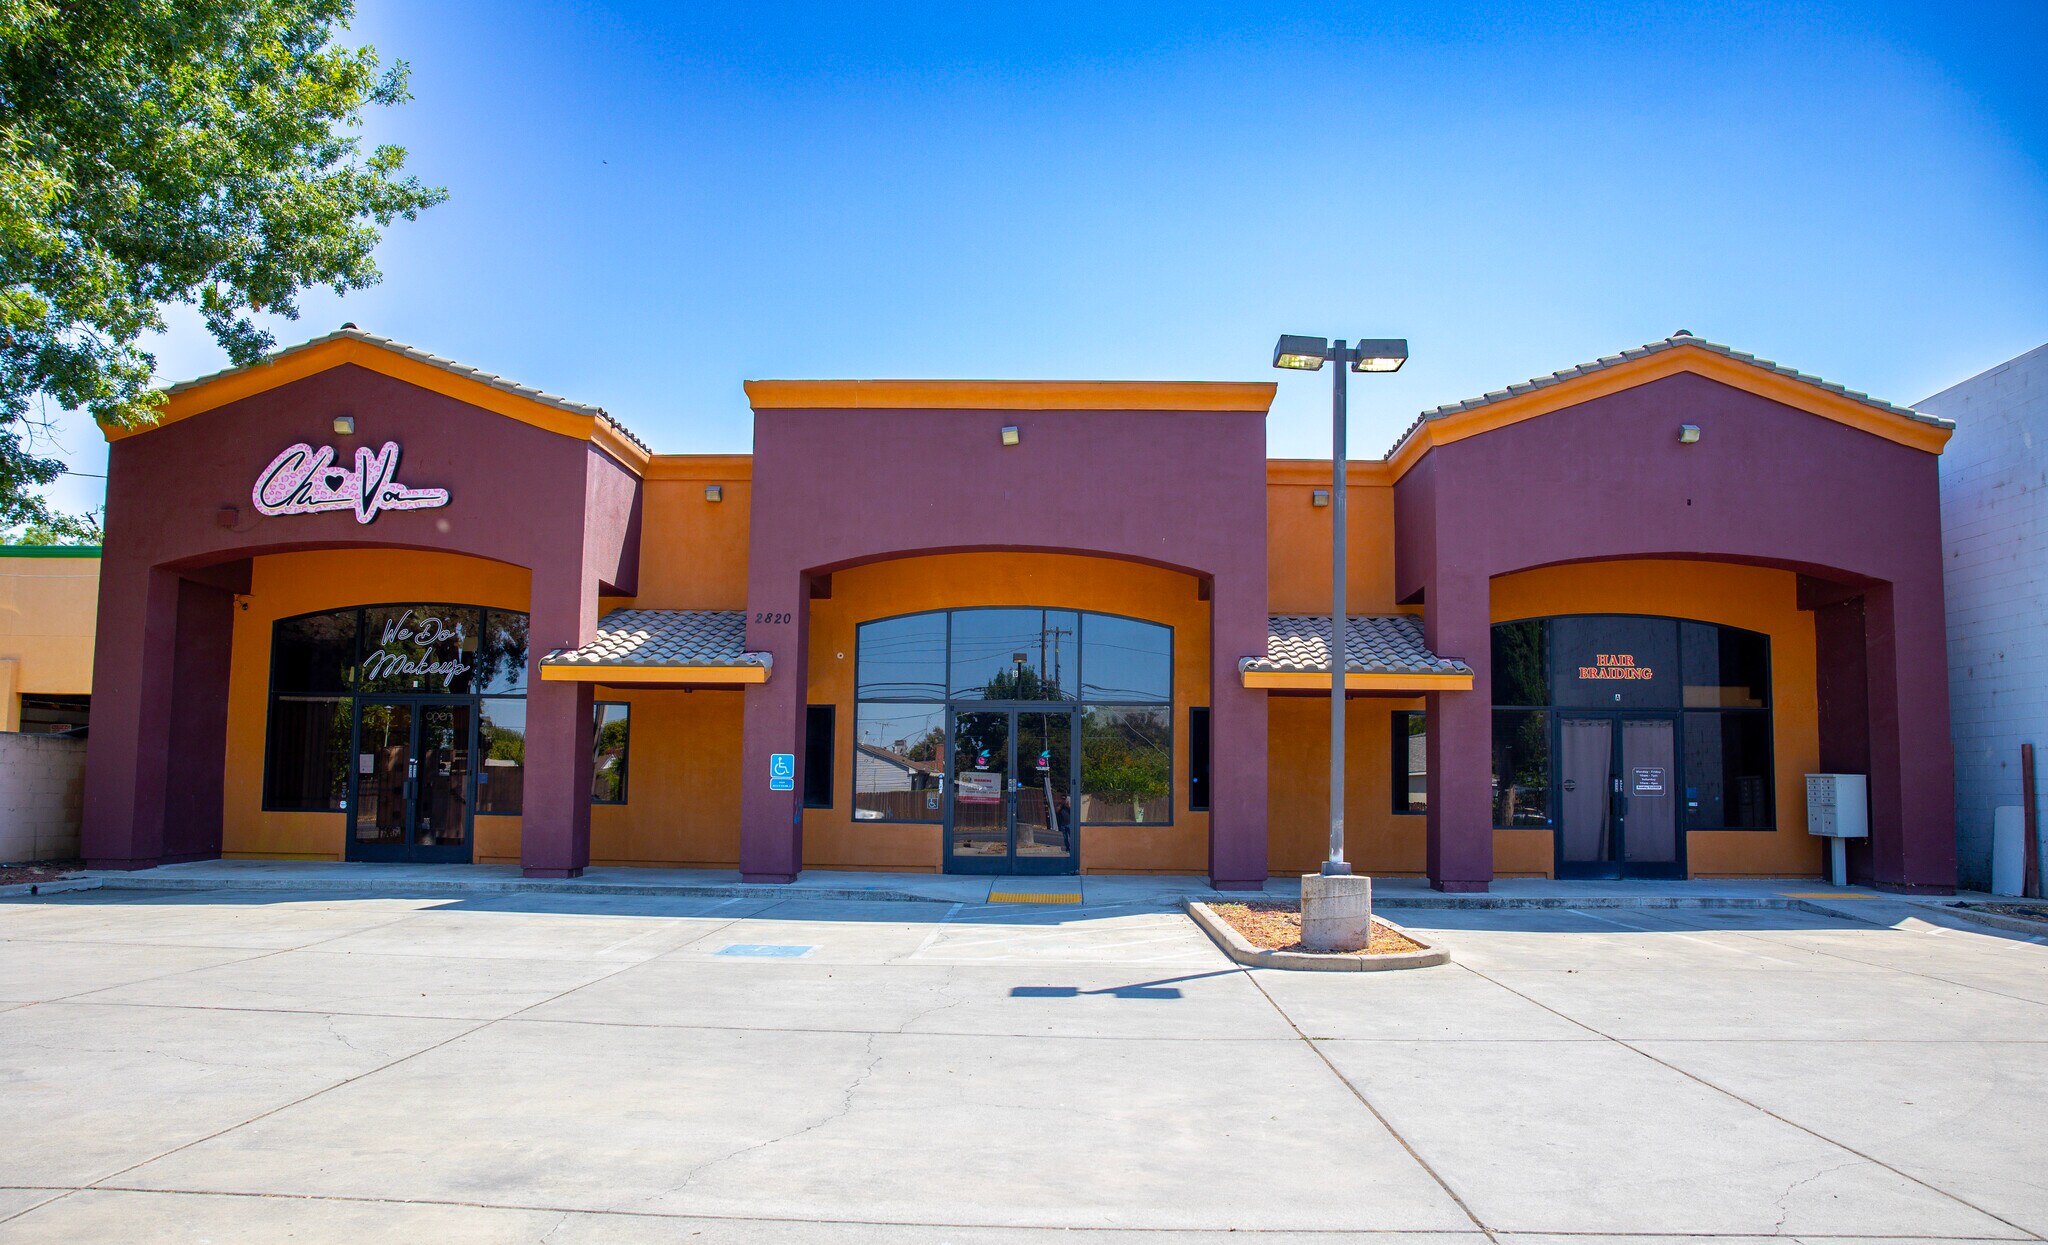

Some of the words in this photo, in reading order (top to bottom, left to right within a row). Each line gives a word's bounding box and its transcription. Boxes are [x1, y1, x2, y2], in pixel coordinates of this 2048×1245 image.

[755, 612, 791, 624] 2820
[381, 609, 414, 646] We
[414, 617, 456, 646] Do
[363, 646, 470, 687] Makeup
[1596, 654, 1635, 666] HAIR
[1578, 667, 1653, 680] BRAIDING
